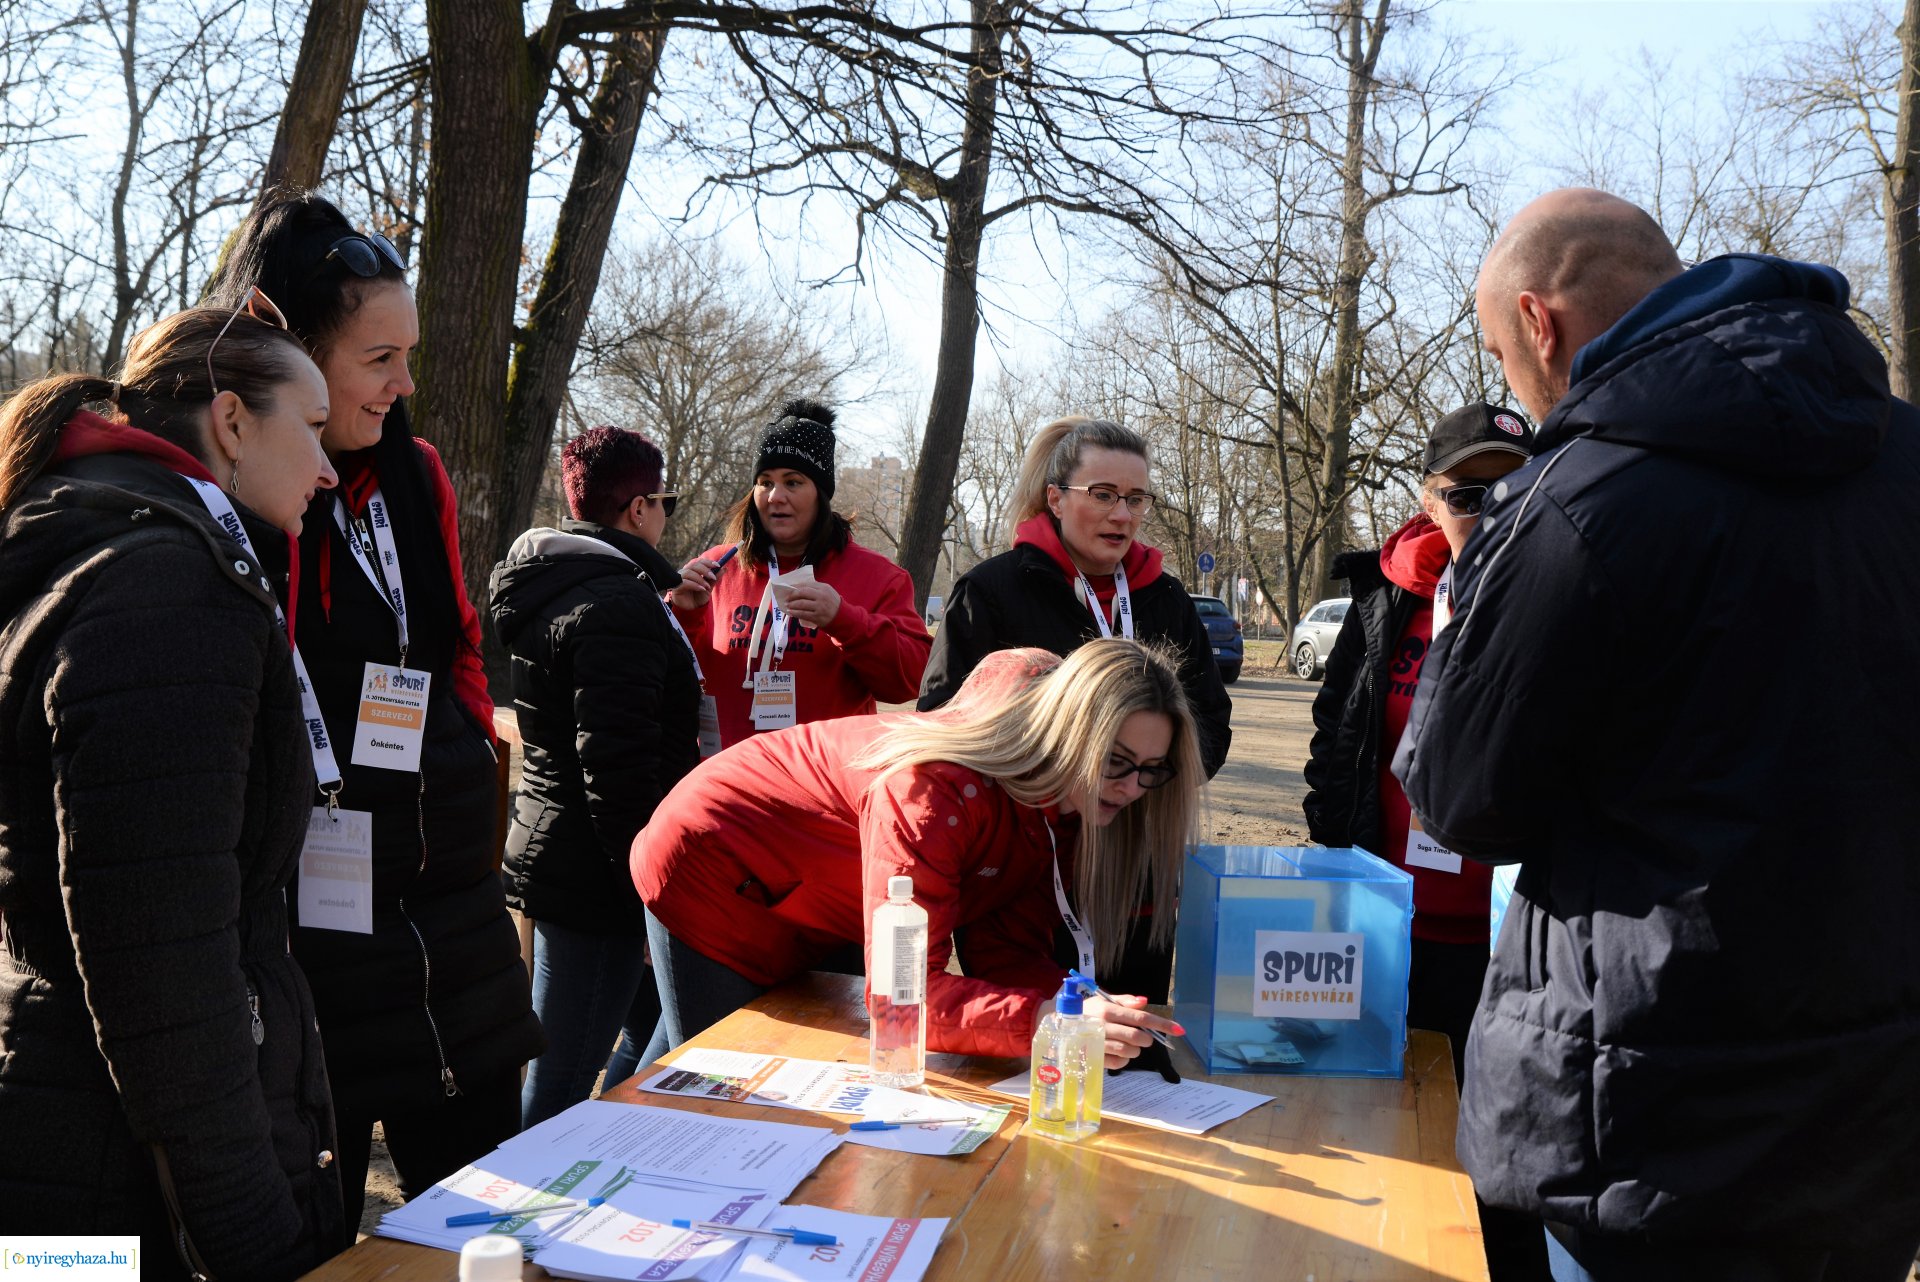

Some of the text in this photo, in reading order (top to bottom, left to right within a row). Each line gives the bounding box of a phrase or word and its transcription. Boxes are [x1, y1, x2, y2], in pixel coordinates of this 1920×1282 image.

[393, 675, 425, 691] SPURi
[1263, 945, 1356, 984] SPURi
[1261, 988, 1354, 1003] NYÍREGYHÁZA
[559, 1164, 589, 1185] SPURI
[477, 1179, 518, 1200] 104
[618, 1222, 662, 1243] 102
[893, 1223, 911, 1245] SPURI
